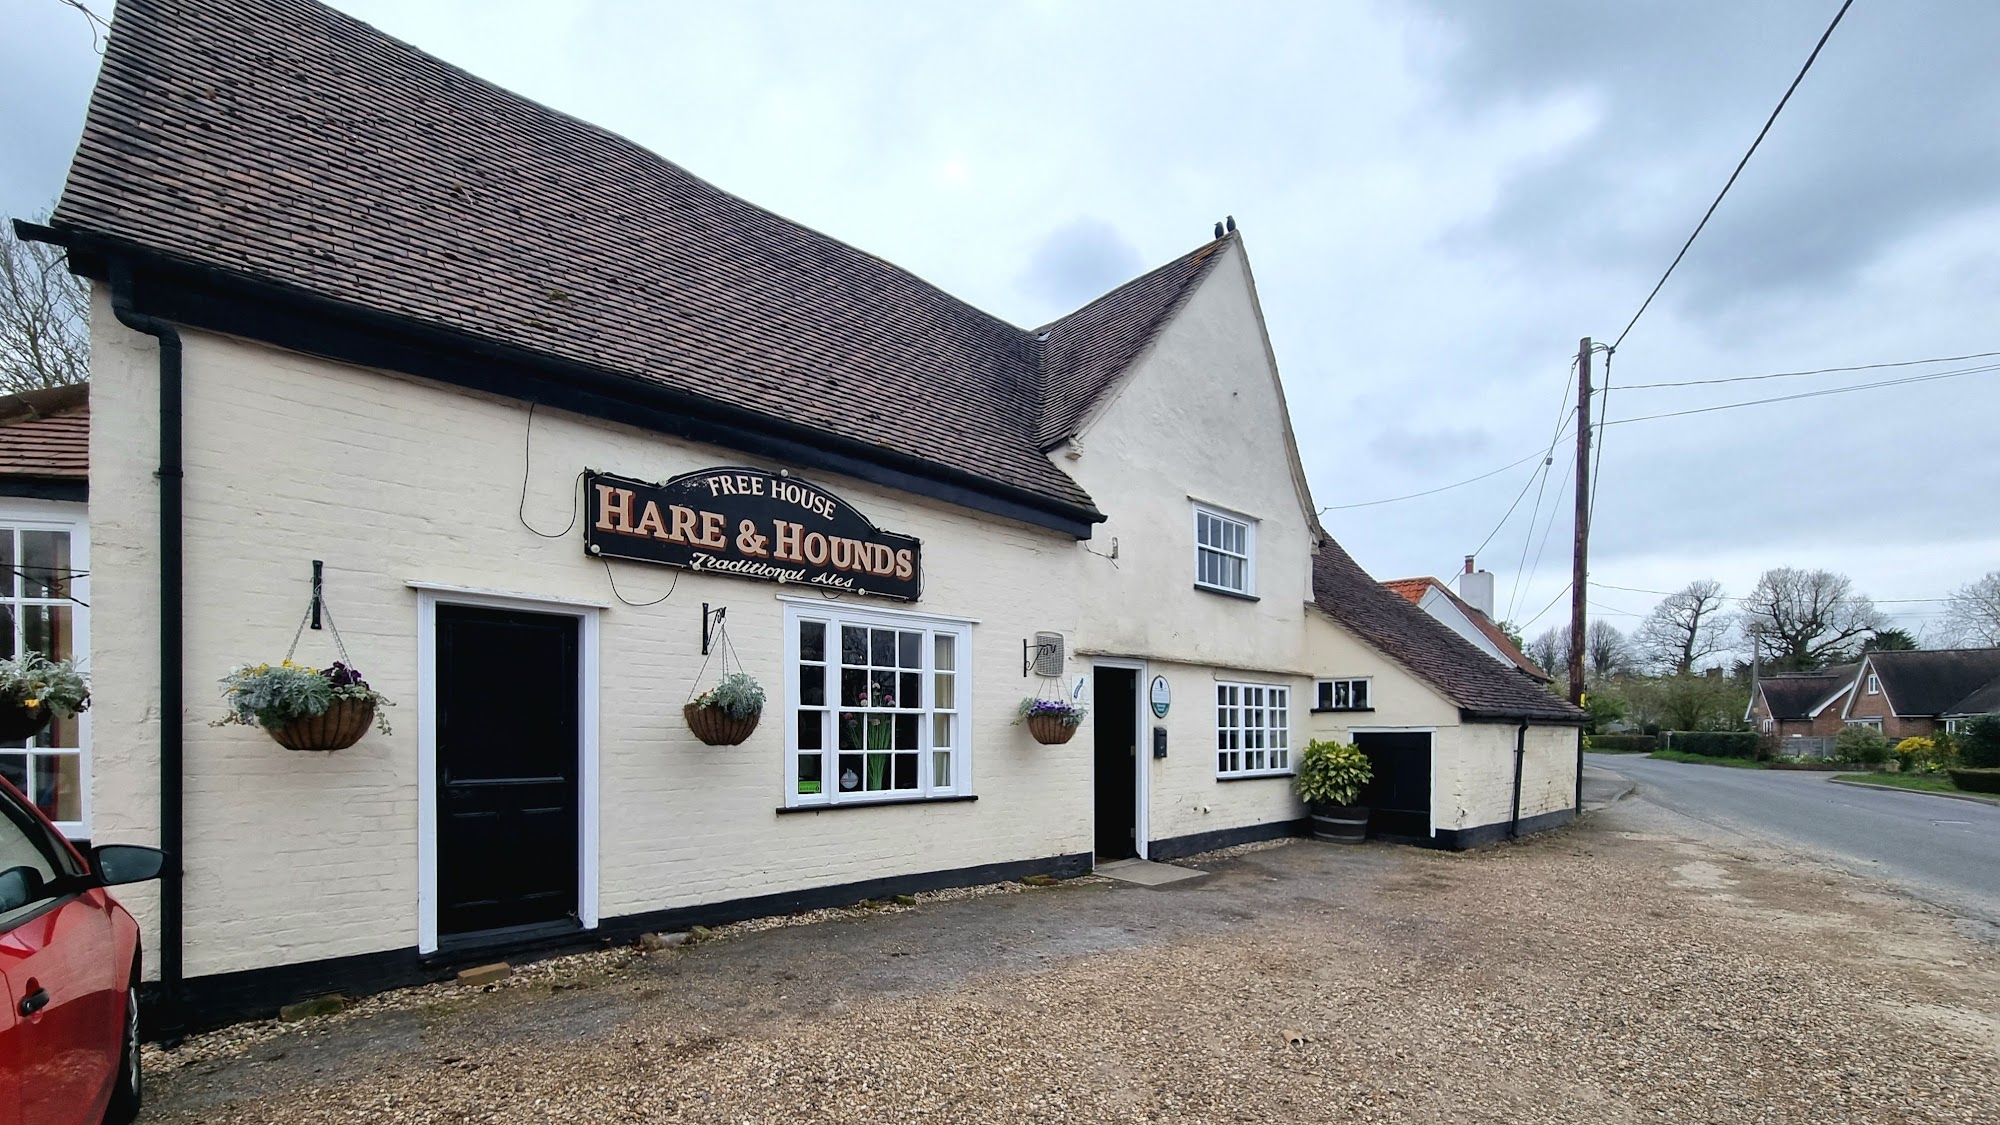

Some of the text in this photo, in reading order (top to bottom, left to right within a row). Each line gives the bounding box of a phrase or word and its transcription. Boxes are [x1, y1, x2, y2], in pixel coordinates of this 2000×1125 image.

[708, 474, 836, 521] FREE HOUSE
[595, 484, 914, 581] HARE & HOUNDS
[691, 551, 854, 588] Traditional Ales
